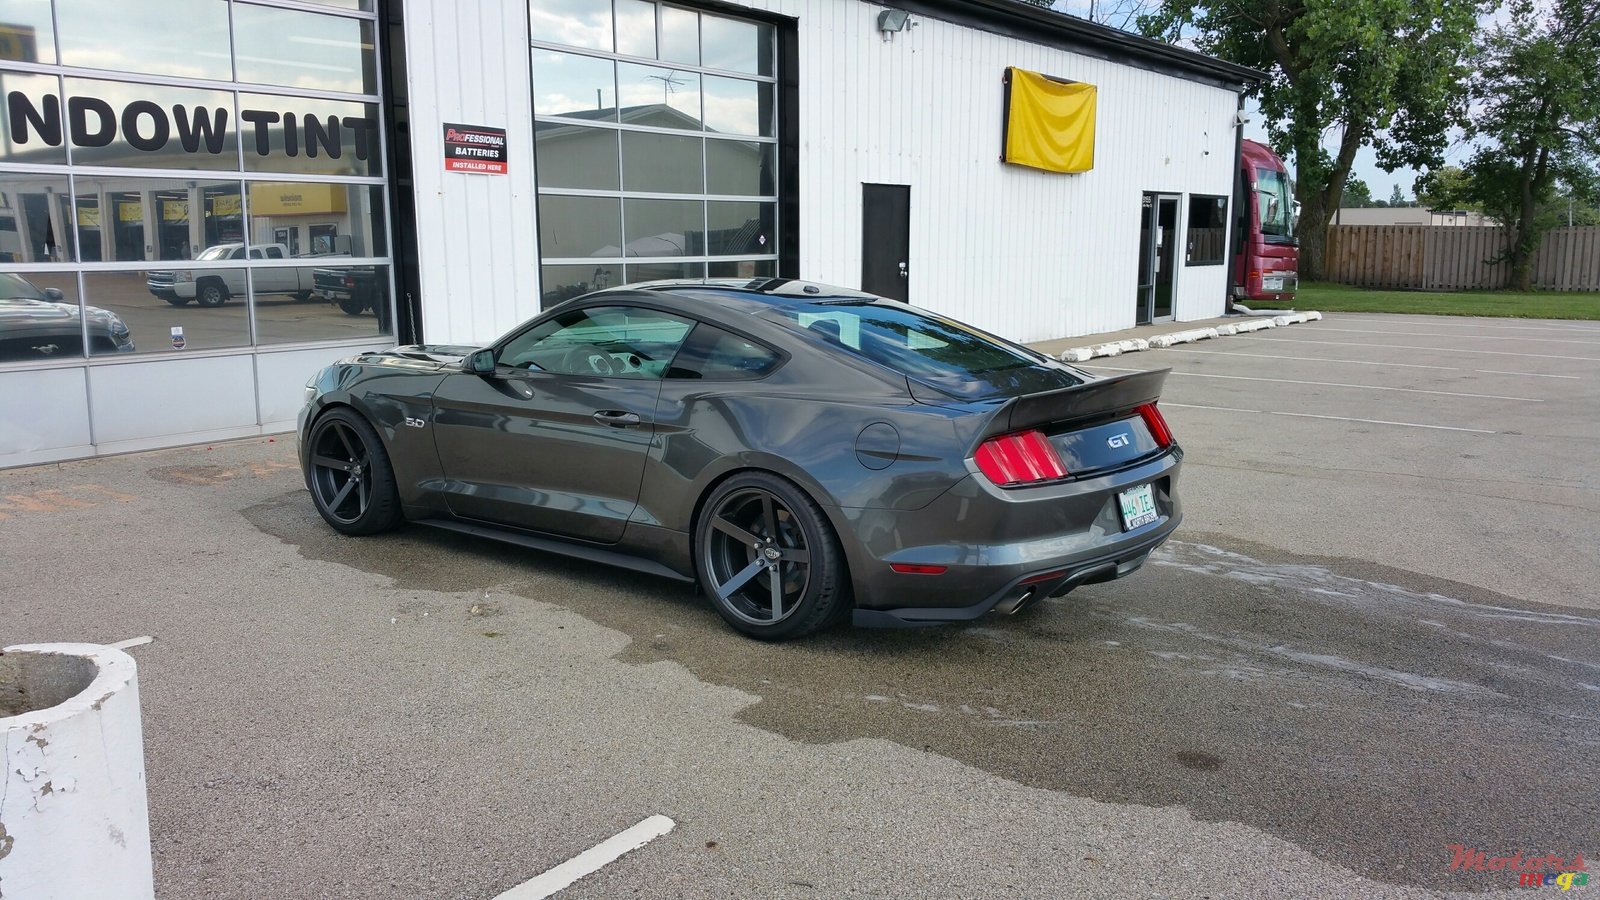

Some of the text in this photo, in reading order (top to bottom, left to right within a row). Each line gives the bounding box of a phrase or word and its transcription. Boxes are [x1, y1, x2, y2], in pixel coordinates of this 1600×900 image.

[8, 91, 376, 160] NDOW TINT
[446, 128, 504, 145] PROFESSIONAL
[455, 147, 499, 158] BATTERIES
[452, 161, 502, 171] INSTALLED HERE
[405, 416, 425, 428] 5.0
[1107, 432, 1129, 449] GT
